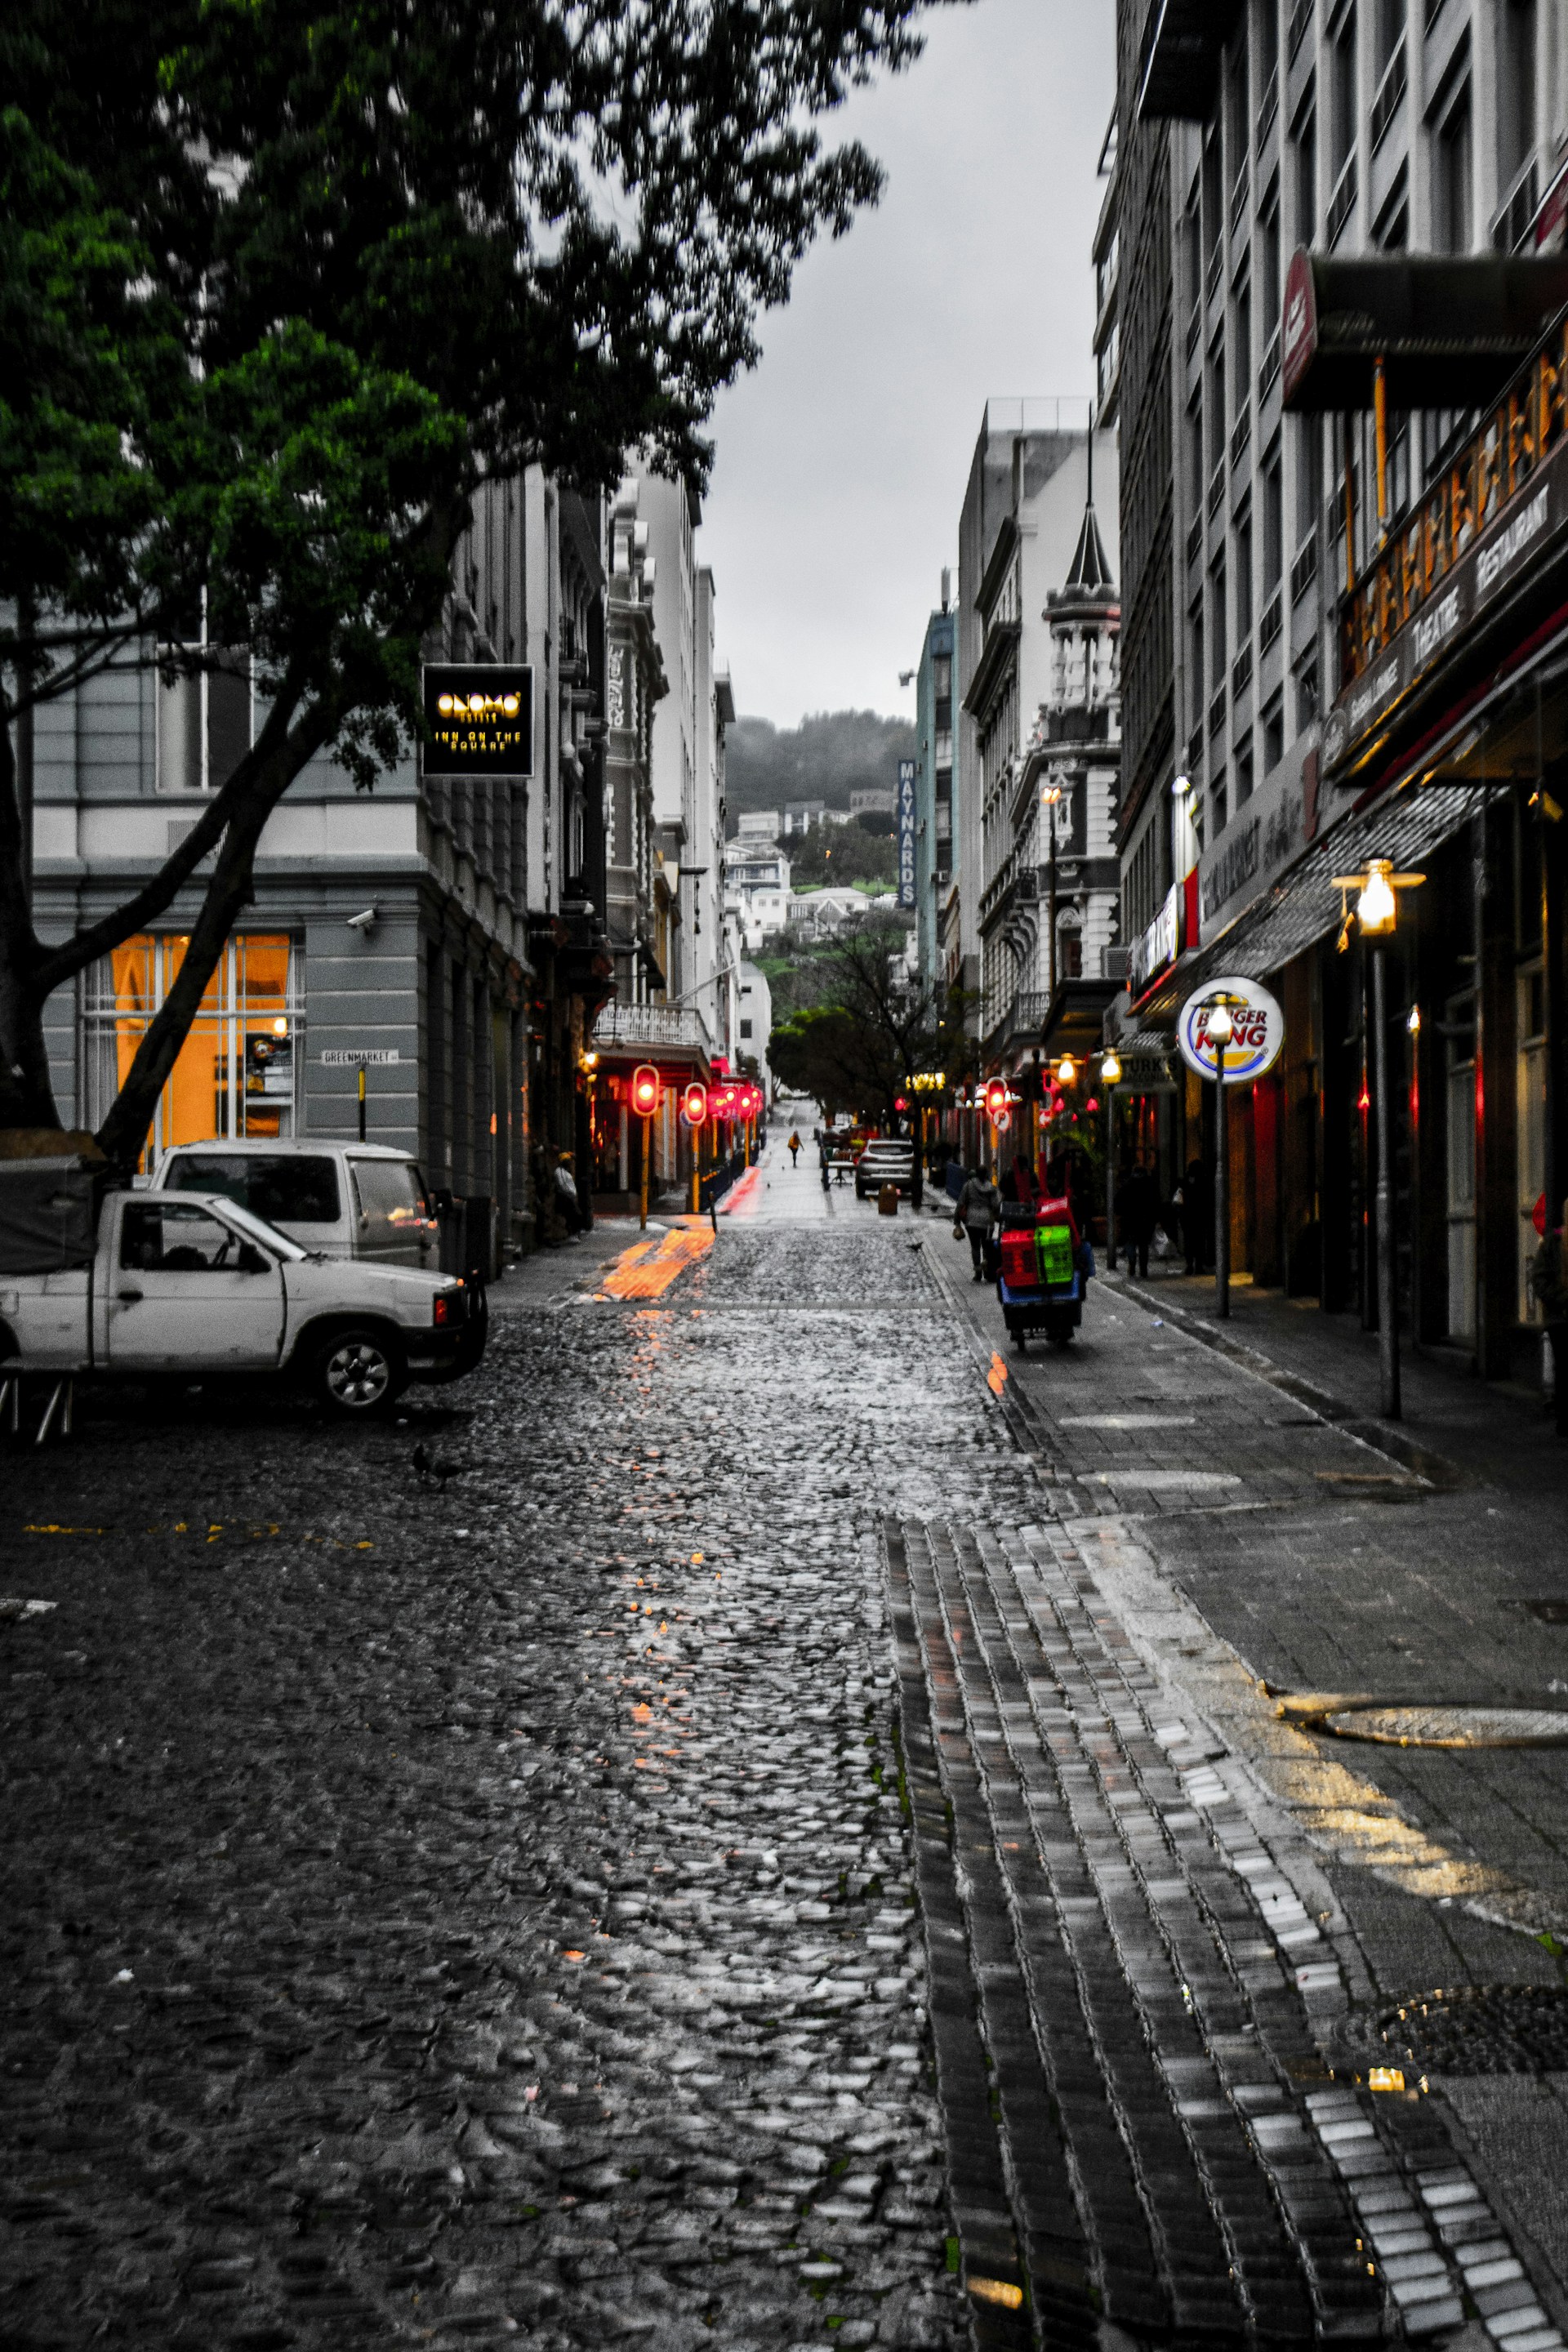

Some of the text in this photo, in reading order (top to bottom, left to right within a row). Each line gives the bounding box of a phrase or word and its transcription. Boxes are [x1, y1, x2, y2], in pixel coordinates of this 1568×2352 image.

[1412, 585, 1459, 664] THEATRE
[1477, 483, 1550, 595] RESTAURANT
[438, 693, 520, 719] ONOMO
[434, 732, 520, 743] INN ON THE
[451, 742, 506, 752] SQUARE
[901, 763, 914, 902] MAYNARDS
[1195, 1025, 1267, 1051] KNG
[325, 1051, 389, 1062] GREENMARKET
